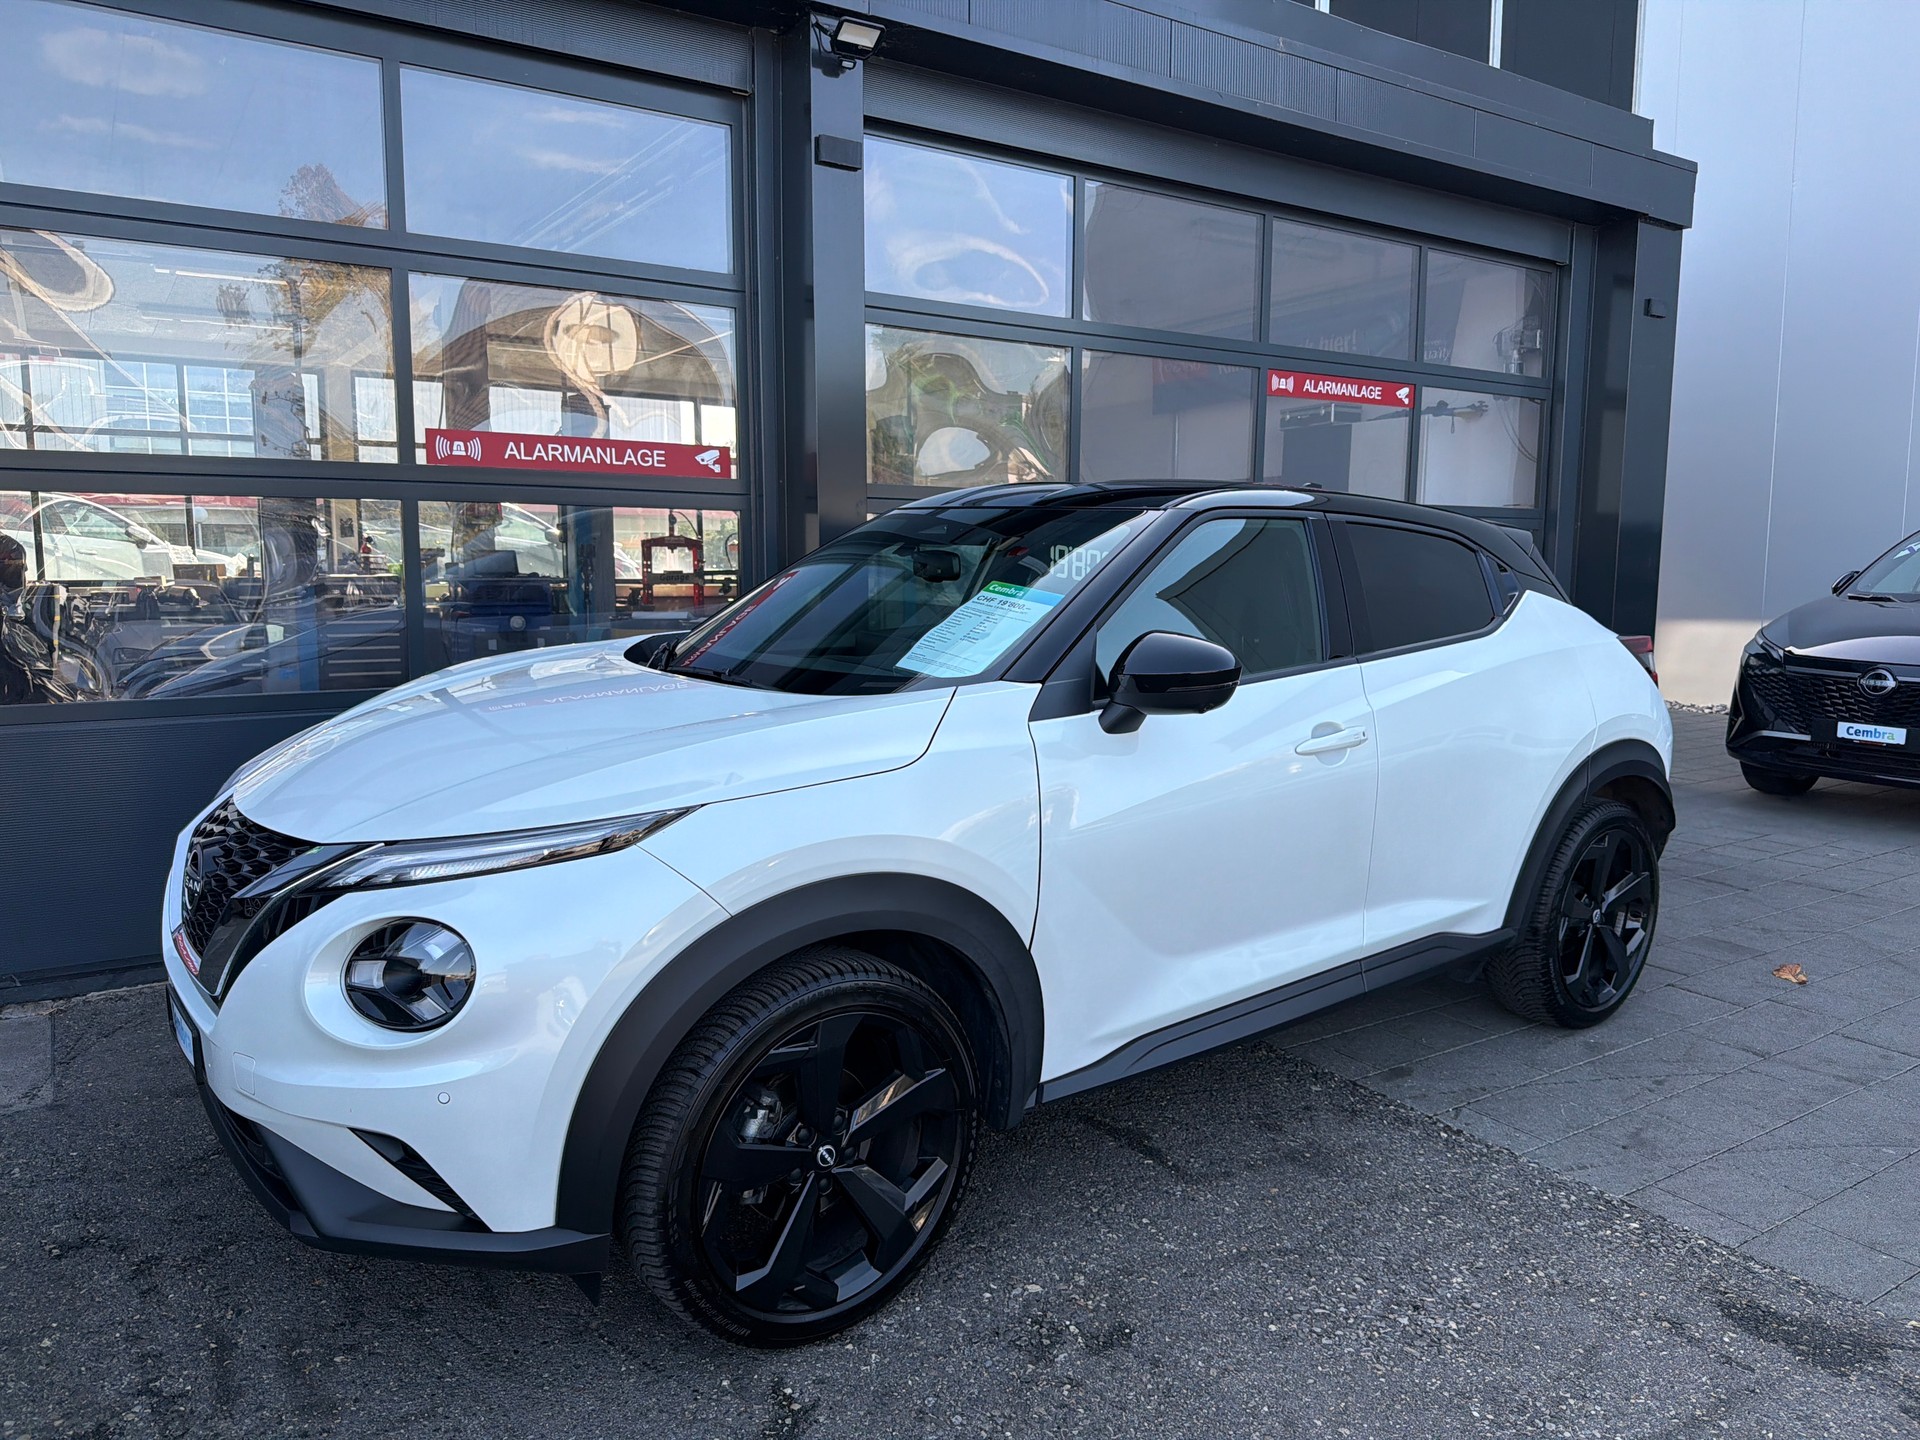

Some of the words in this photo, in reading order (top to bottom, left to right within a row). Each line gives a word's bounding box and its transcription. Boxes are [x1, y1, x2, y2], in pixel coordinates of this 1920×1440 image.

[1303, 379, 1382, 400] ALARMANLAGE
[504, 441, 667, 468] ALARMANLAGE
[989, 583, 1025, 597] Cembra
[976, 595, 997, 603] CHF
[1846, 725, 1896, 741] Cembra
